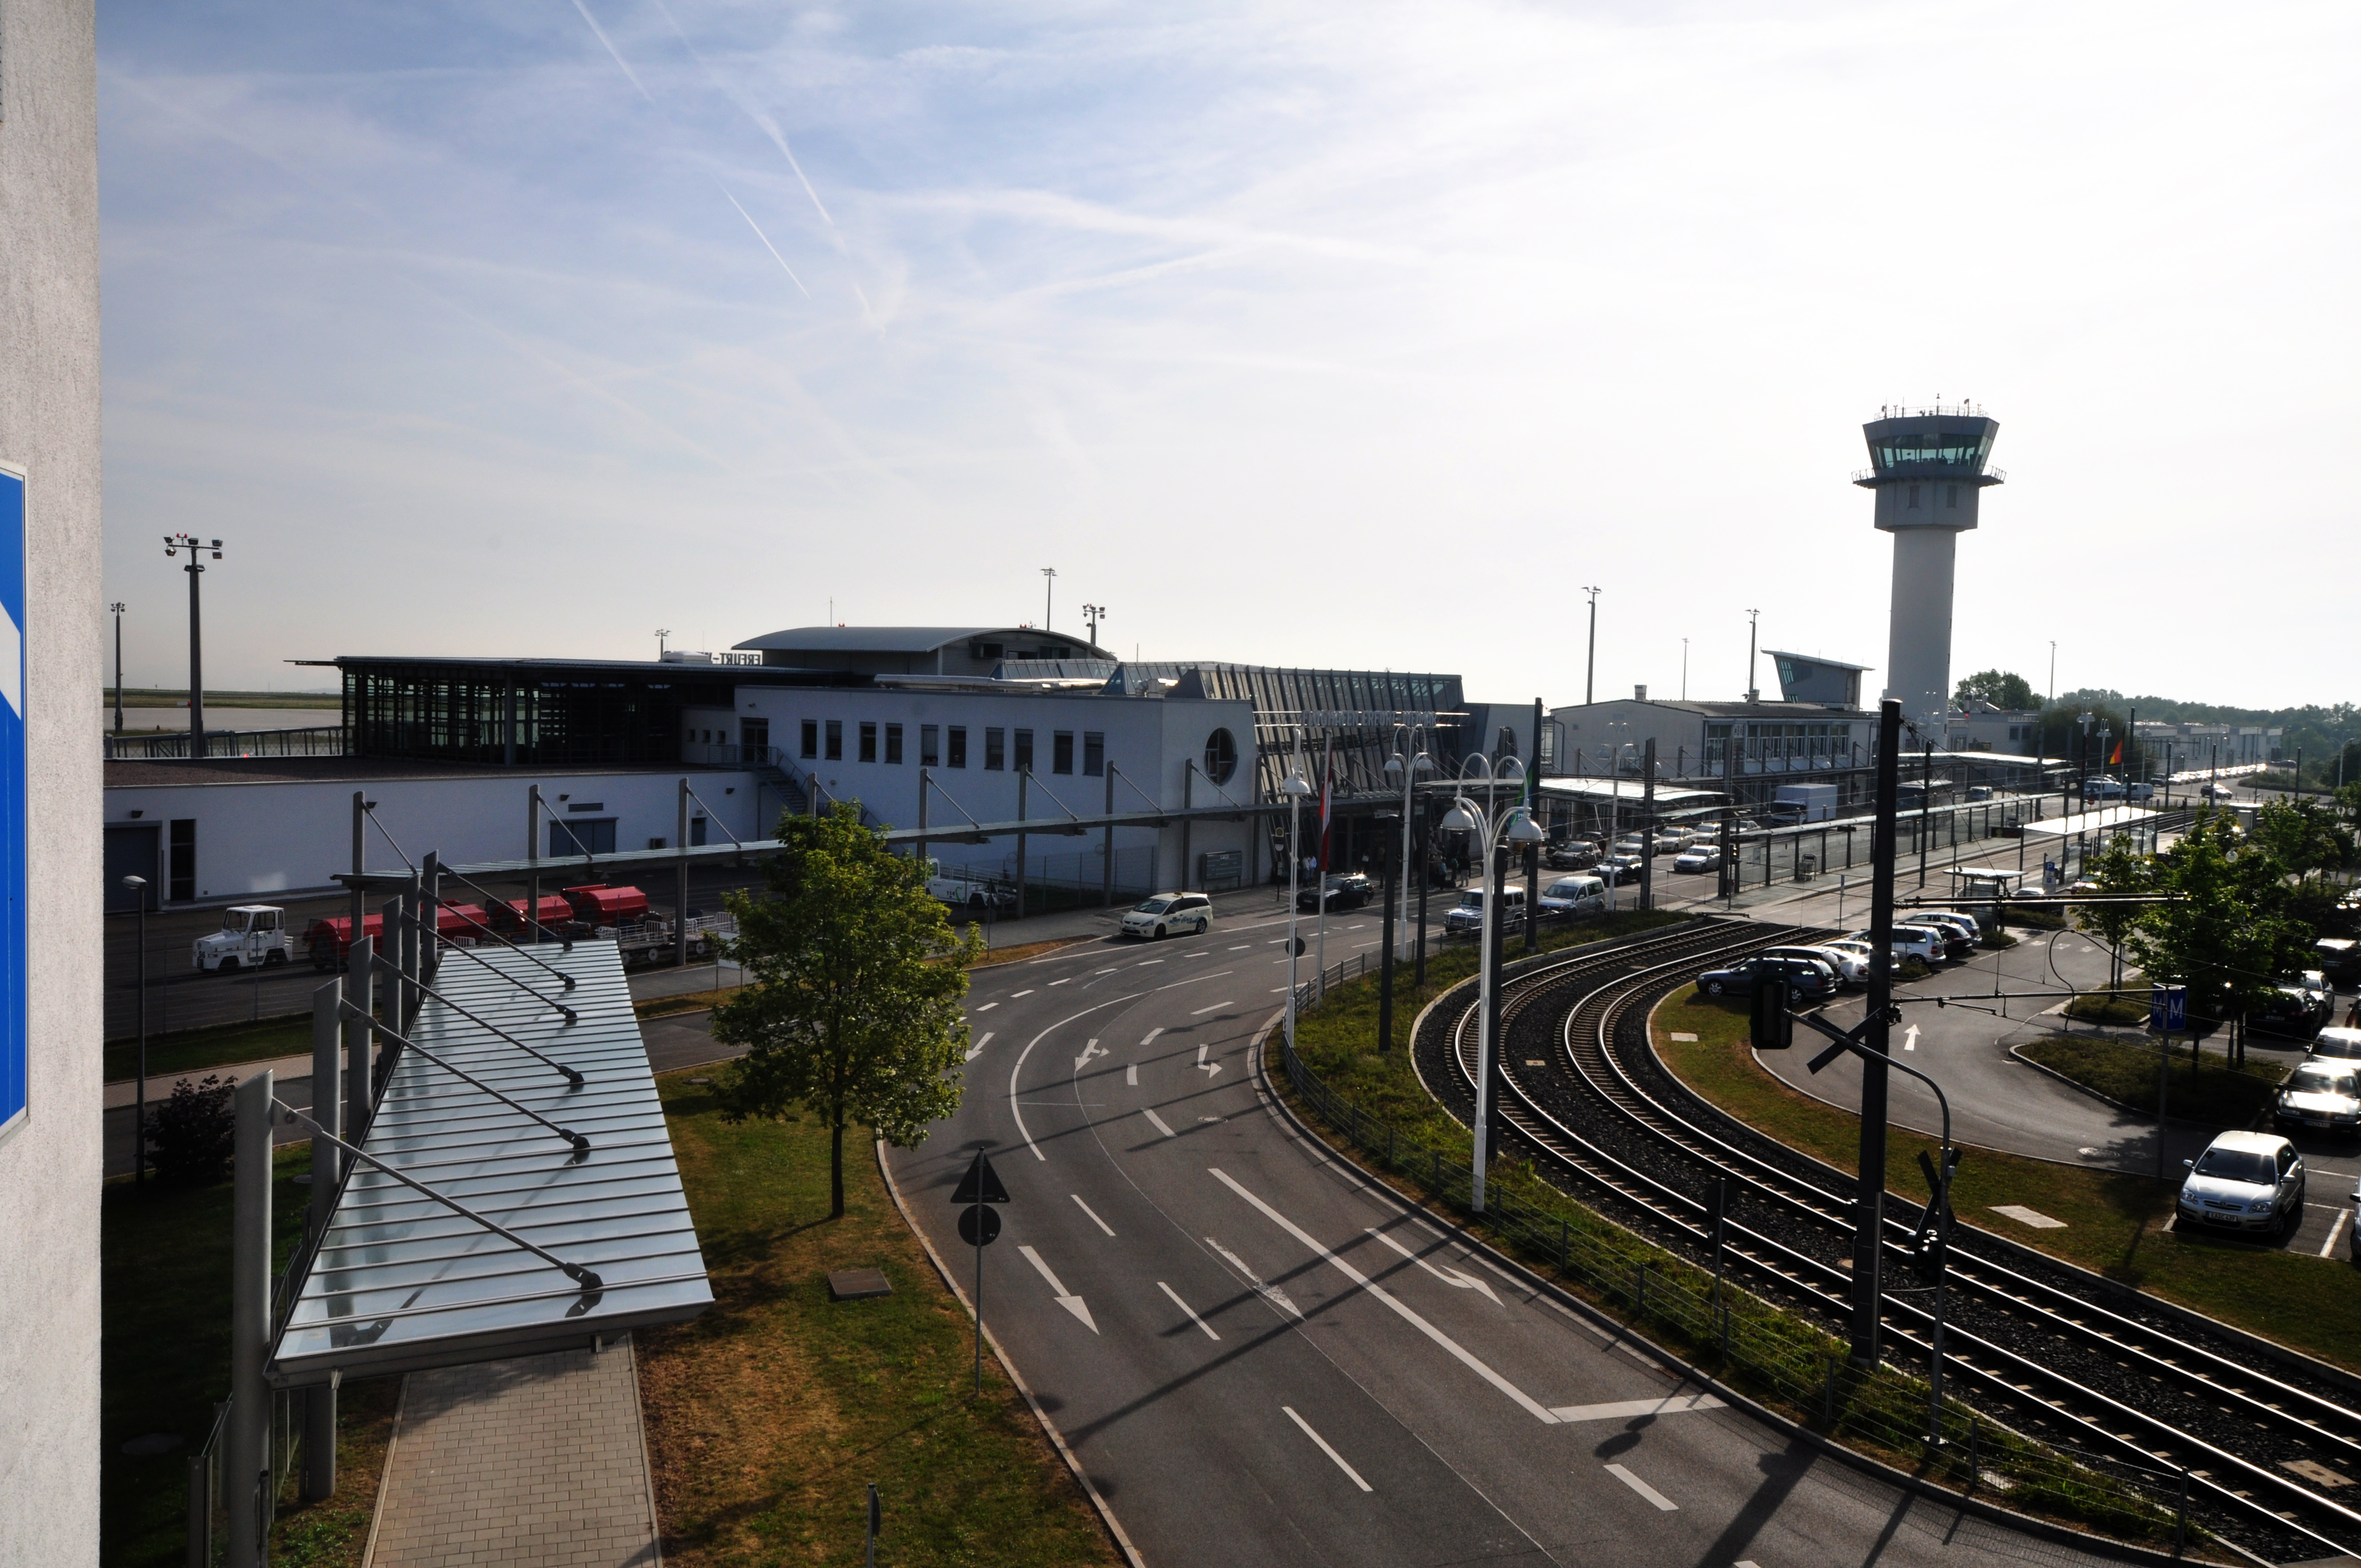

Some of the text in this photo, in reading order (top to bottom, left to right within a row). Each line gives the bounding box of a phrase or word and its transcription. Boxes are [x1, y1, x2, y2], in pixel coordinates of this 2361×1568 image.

[1302, 710, 1359, 726] FLUGHAFEN
[1363, 710, 1396, 726] ERFURT
[1403, 711, 1437, 726] WEIMAR
[2170, 998, 2183, 1019] M
